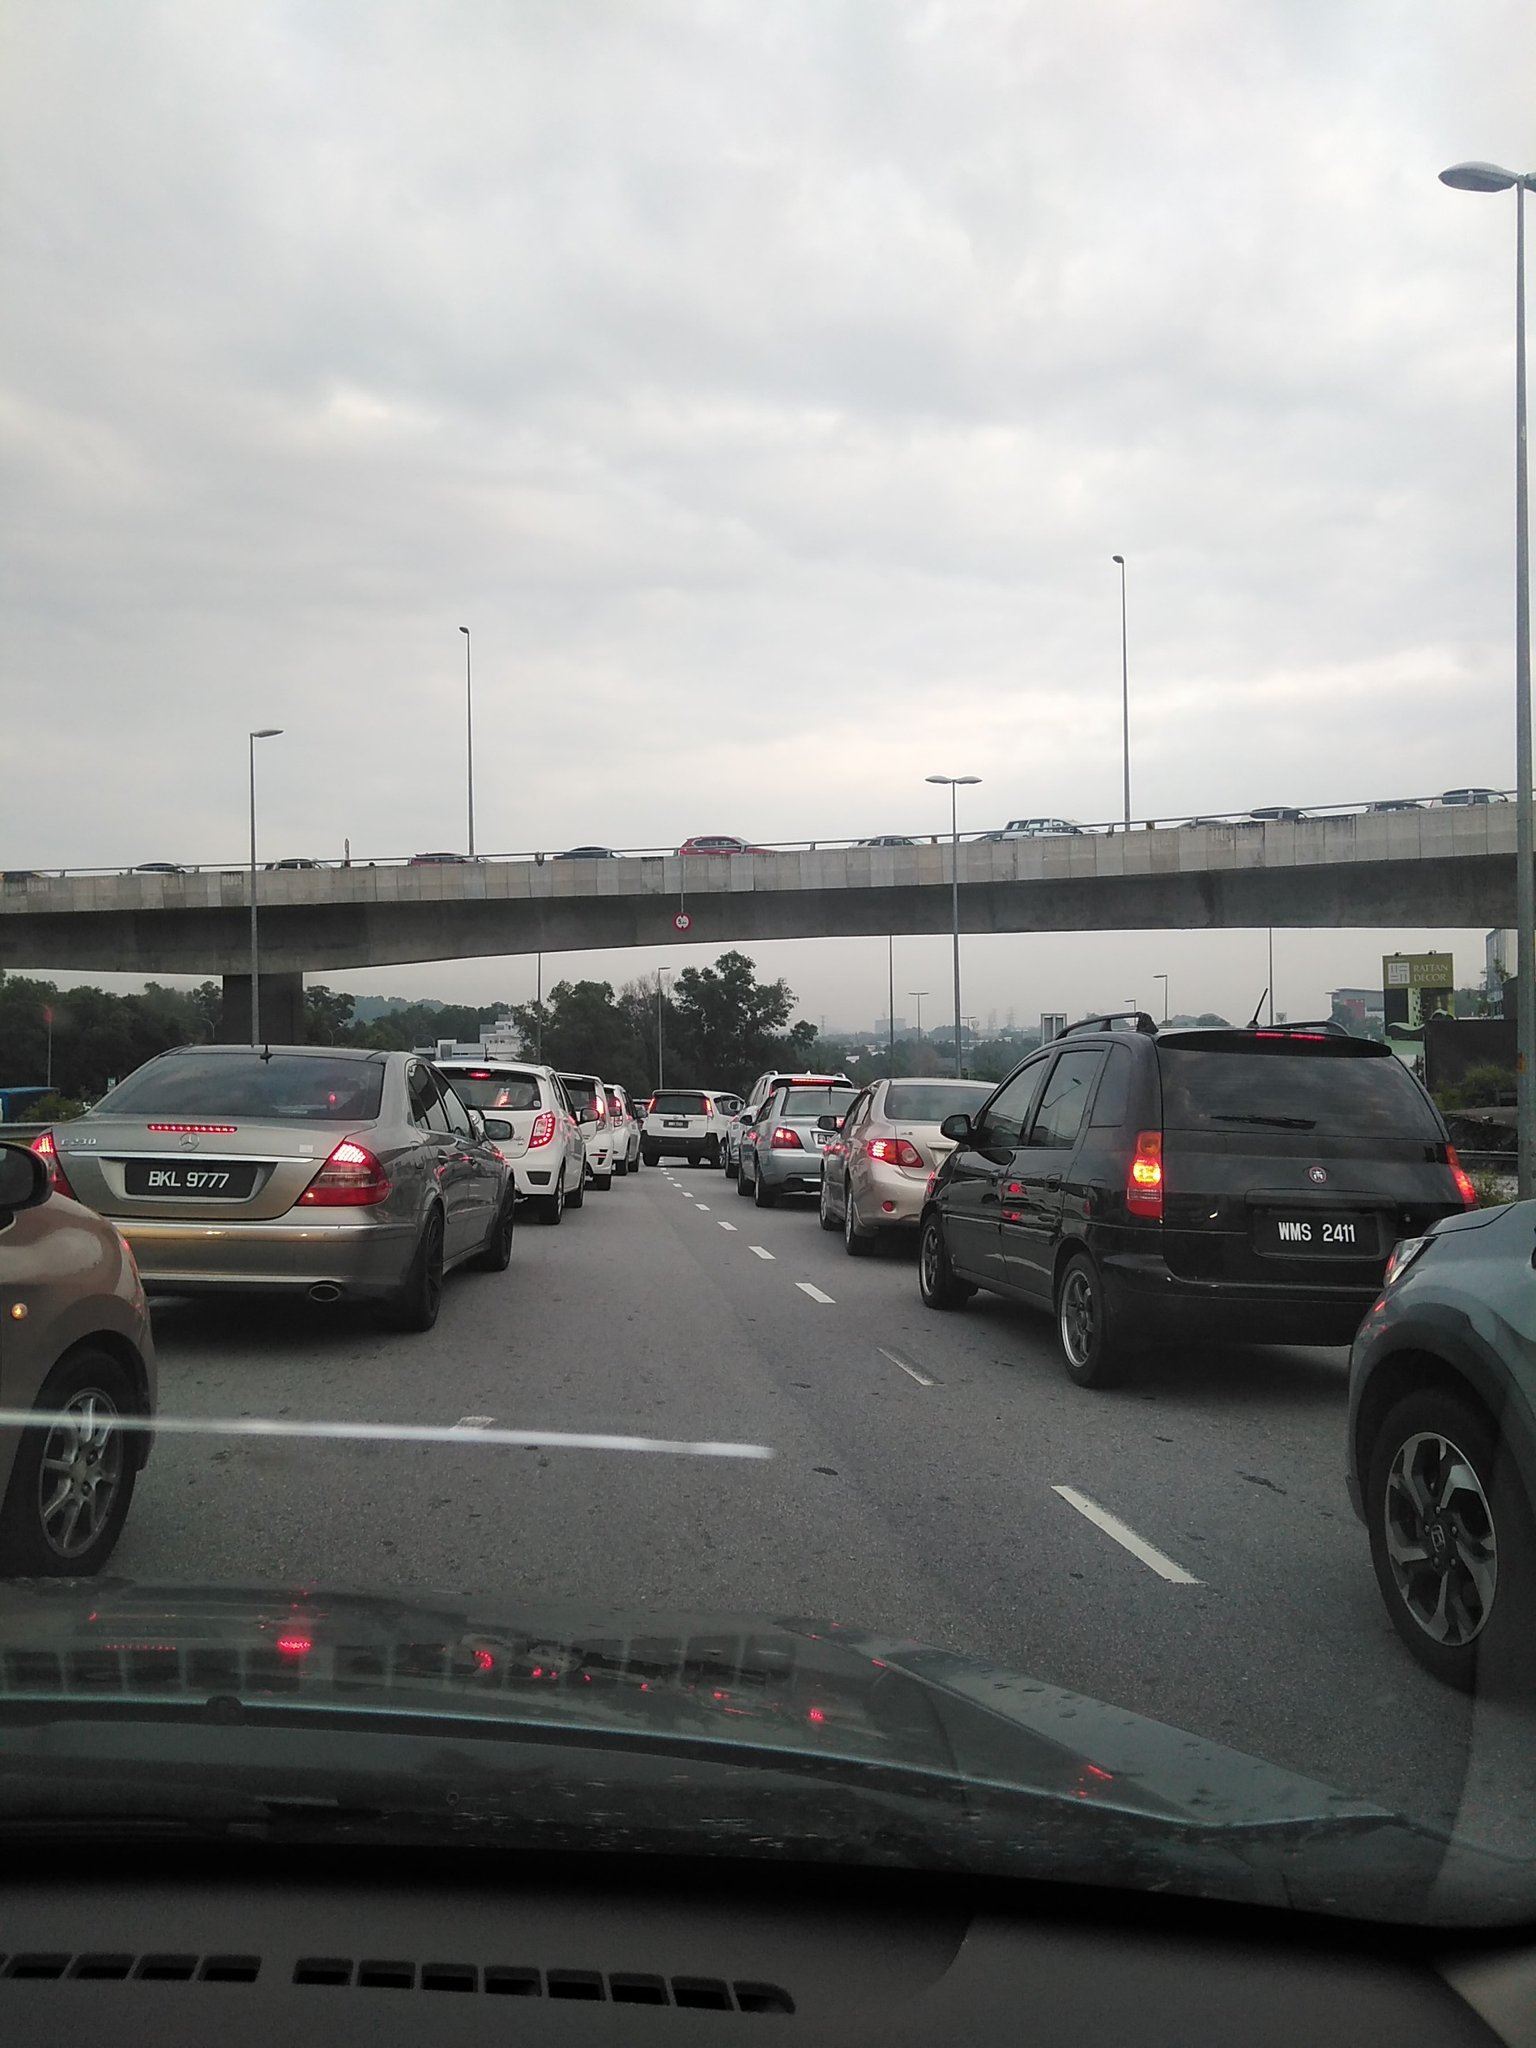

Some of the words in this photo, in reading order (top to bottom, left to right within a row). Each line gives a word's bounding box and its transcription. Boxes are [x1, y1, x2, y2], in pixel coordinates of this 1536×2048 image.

[1413, 964, 1448, 973] RATTAN
[1413, 973, 1446, 982] DECOR
[148, 1170, 182, 1187] BKL
[186, 1171, 230, 1189] 9777
[1278, 1222, 1312, 1242] WMS
[1322, 1223, 1356, 1243] 2411
